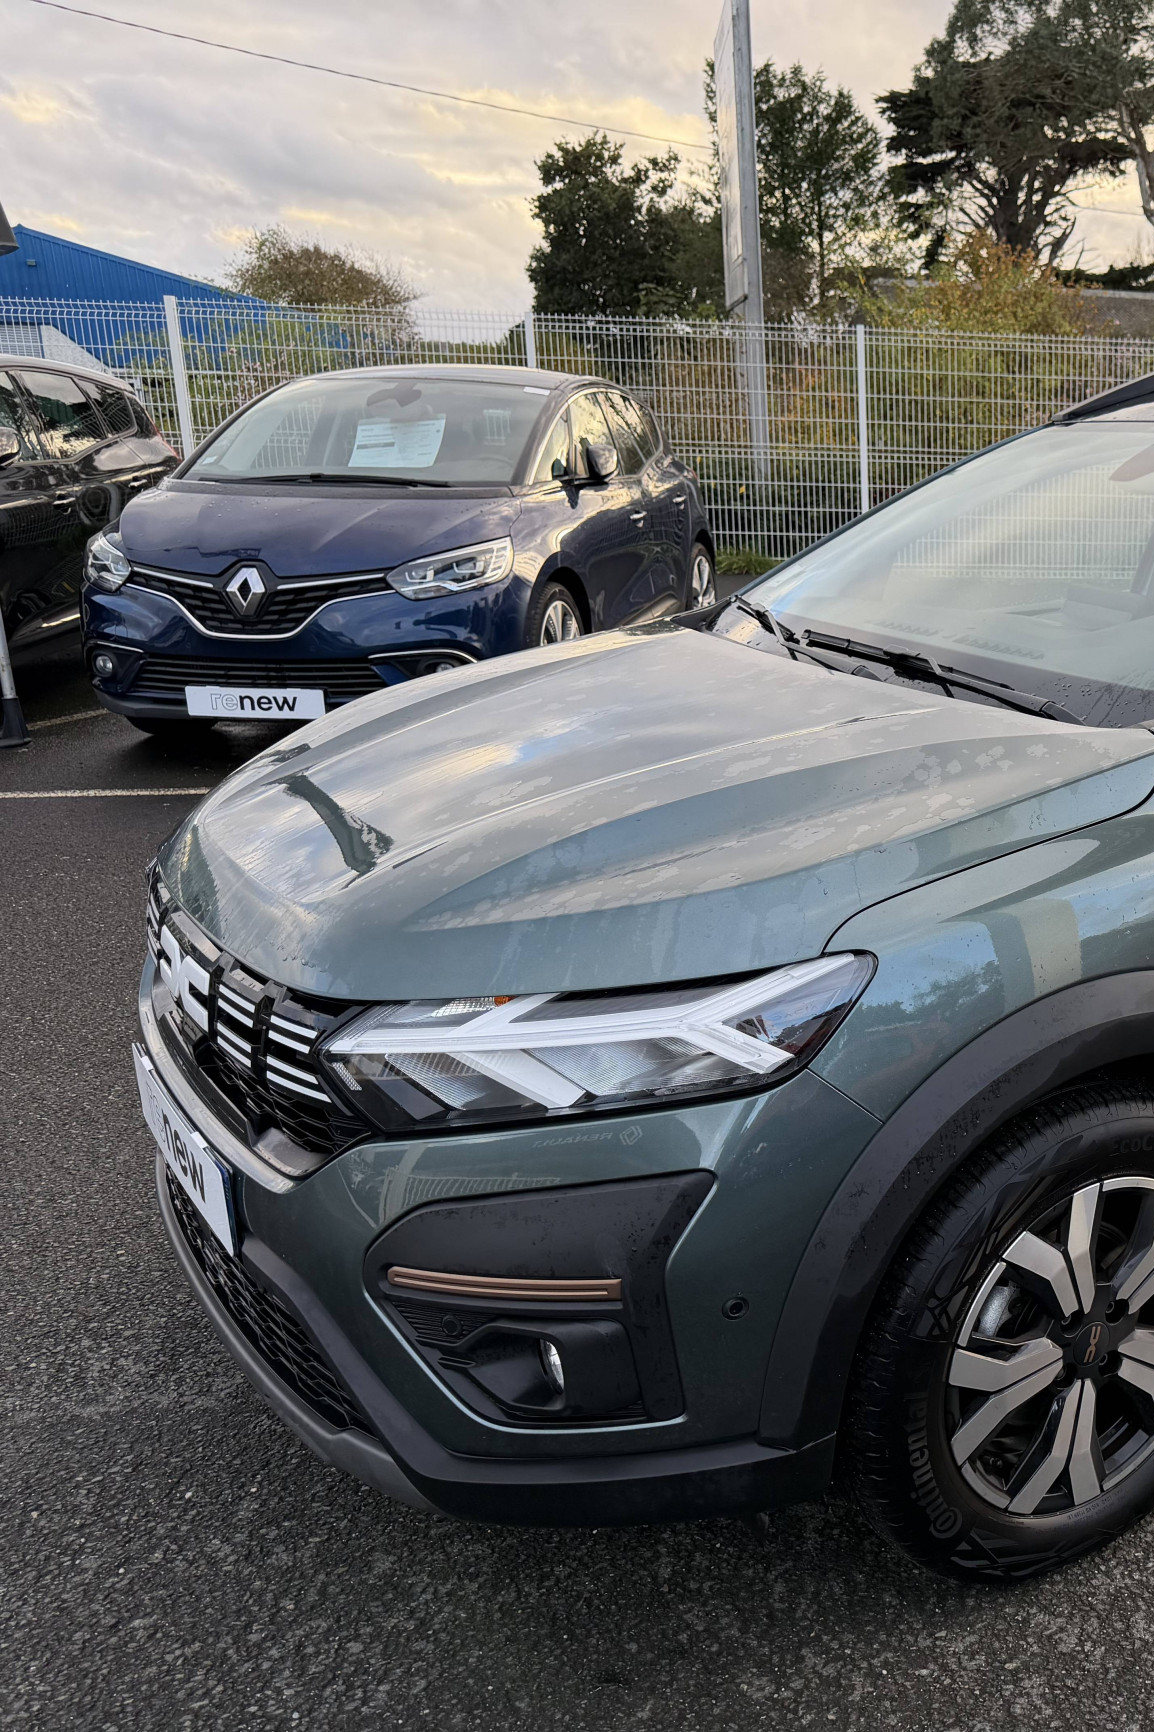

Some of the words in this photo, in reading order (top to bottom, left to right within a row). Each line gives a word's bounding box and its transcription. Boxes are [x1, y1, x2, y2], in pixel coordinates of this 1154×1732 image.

[210, 693, 298, 712] renew
[145, 1080, 206, 1204] renew
[903, 1391, 963, 1539] Continental
